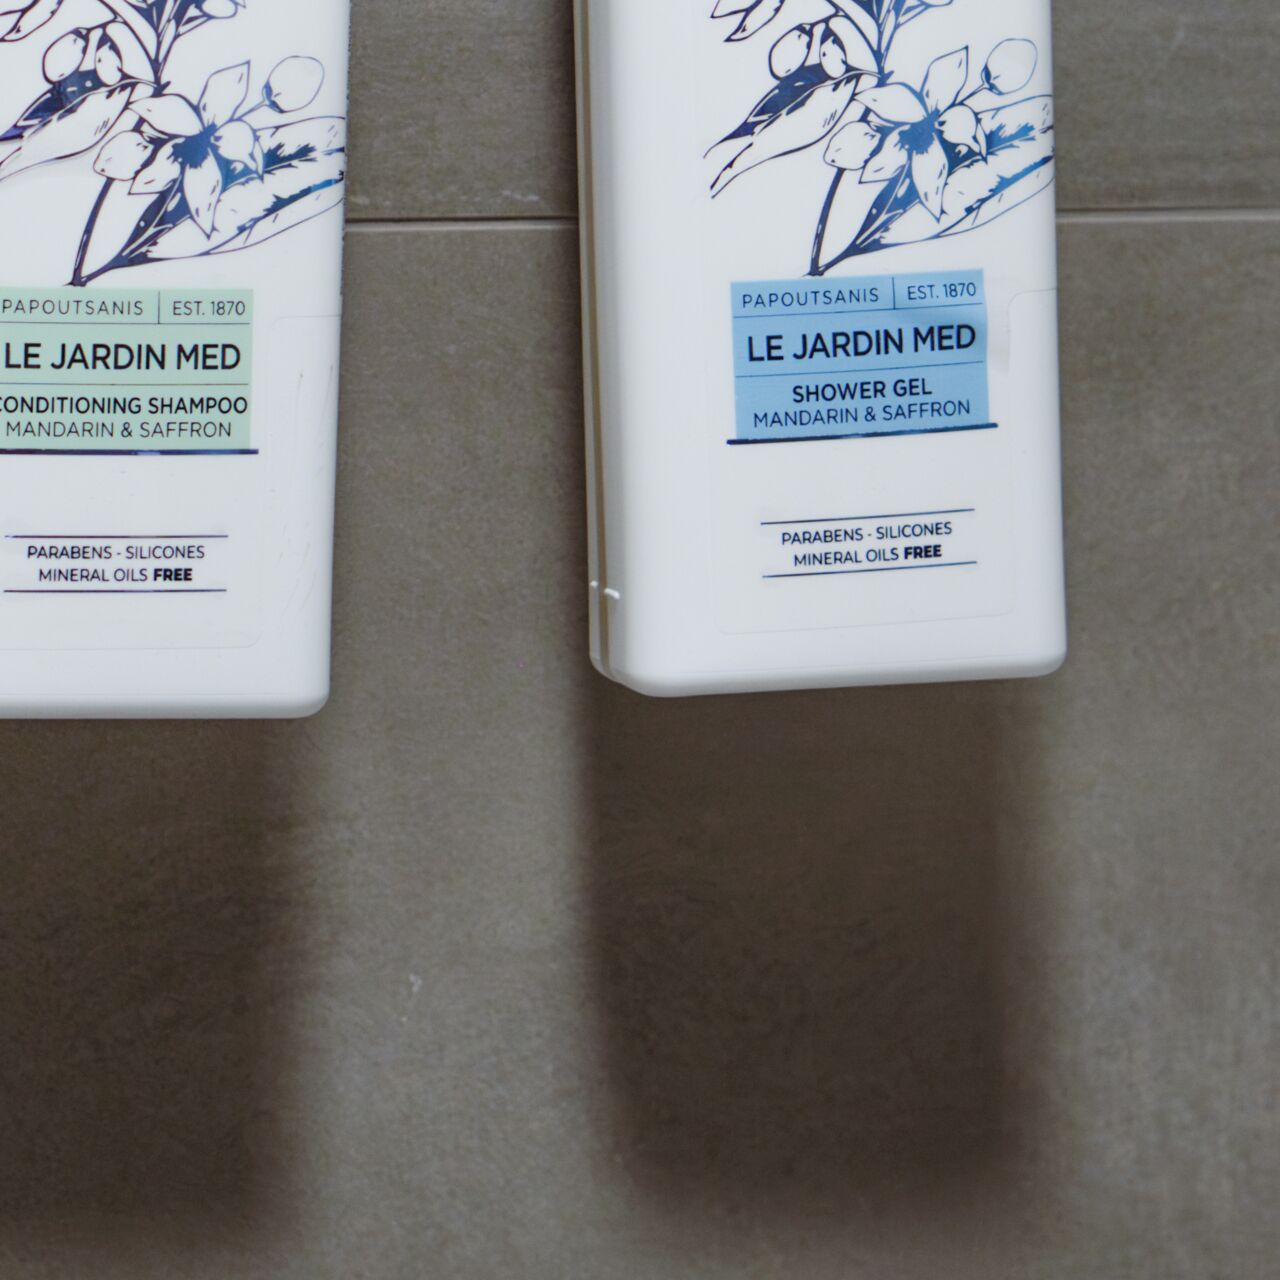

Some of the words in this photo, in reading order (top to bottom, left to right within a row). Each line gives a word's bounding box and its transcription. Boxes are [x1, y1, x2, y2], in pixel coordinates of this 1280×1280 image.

[1, 298, 144, 316] PAPOUTSANIS
[172, 300, 206, 316] EST.
[210, 300, 246, 316] 1870
[742, 287, 880, 309] PAPOUTSANIS
[907, 284, 940, 301] EST.
[943, 282, 977, 298] 1870
[747, 334, 785, 362] LE
[792, 327, 904, 360] JARDIN
[913, 323, 977, 352] MED
[4, 342, 42, 369] LE
[50, 342, 166, 370] JARDIN
[176, 343, 242, 370] MED
[792, 380, 887, 403] SHOWER
[893, 377, 933, 398] GEL
[147, 396, 248, 414] SHAMPOO
[753, 406, 859, 429] MANDARIN
[864, 405, 877, 422] &
[882, 399, 971, 421] SAFFRON
[5, 420, 114, 438] MANDARIN
[120, 421, 133, 438] &
[139, 421, 232, 438] SAFFRON
[781, 527, 864, 546] PARABENS
[875, 521, 953, 540] SILICONES
[26, 545, 112, 560] PARABENS
[125, 545, 205, 560] SILICONES
[793, 549, 863, 567] MINERAL
[865, 547, 900, 563] OILS
[903, 544, 943, 560] FREE
[38, 567, 110, 583] MINERAL
[113, 567, 148, 582] OILS
[152, 567, 193, 582] FREE
